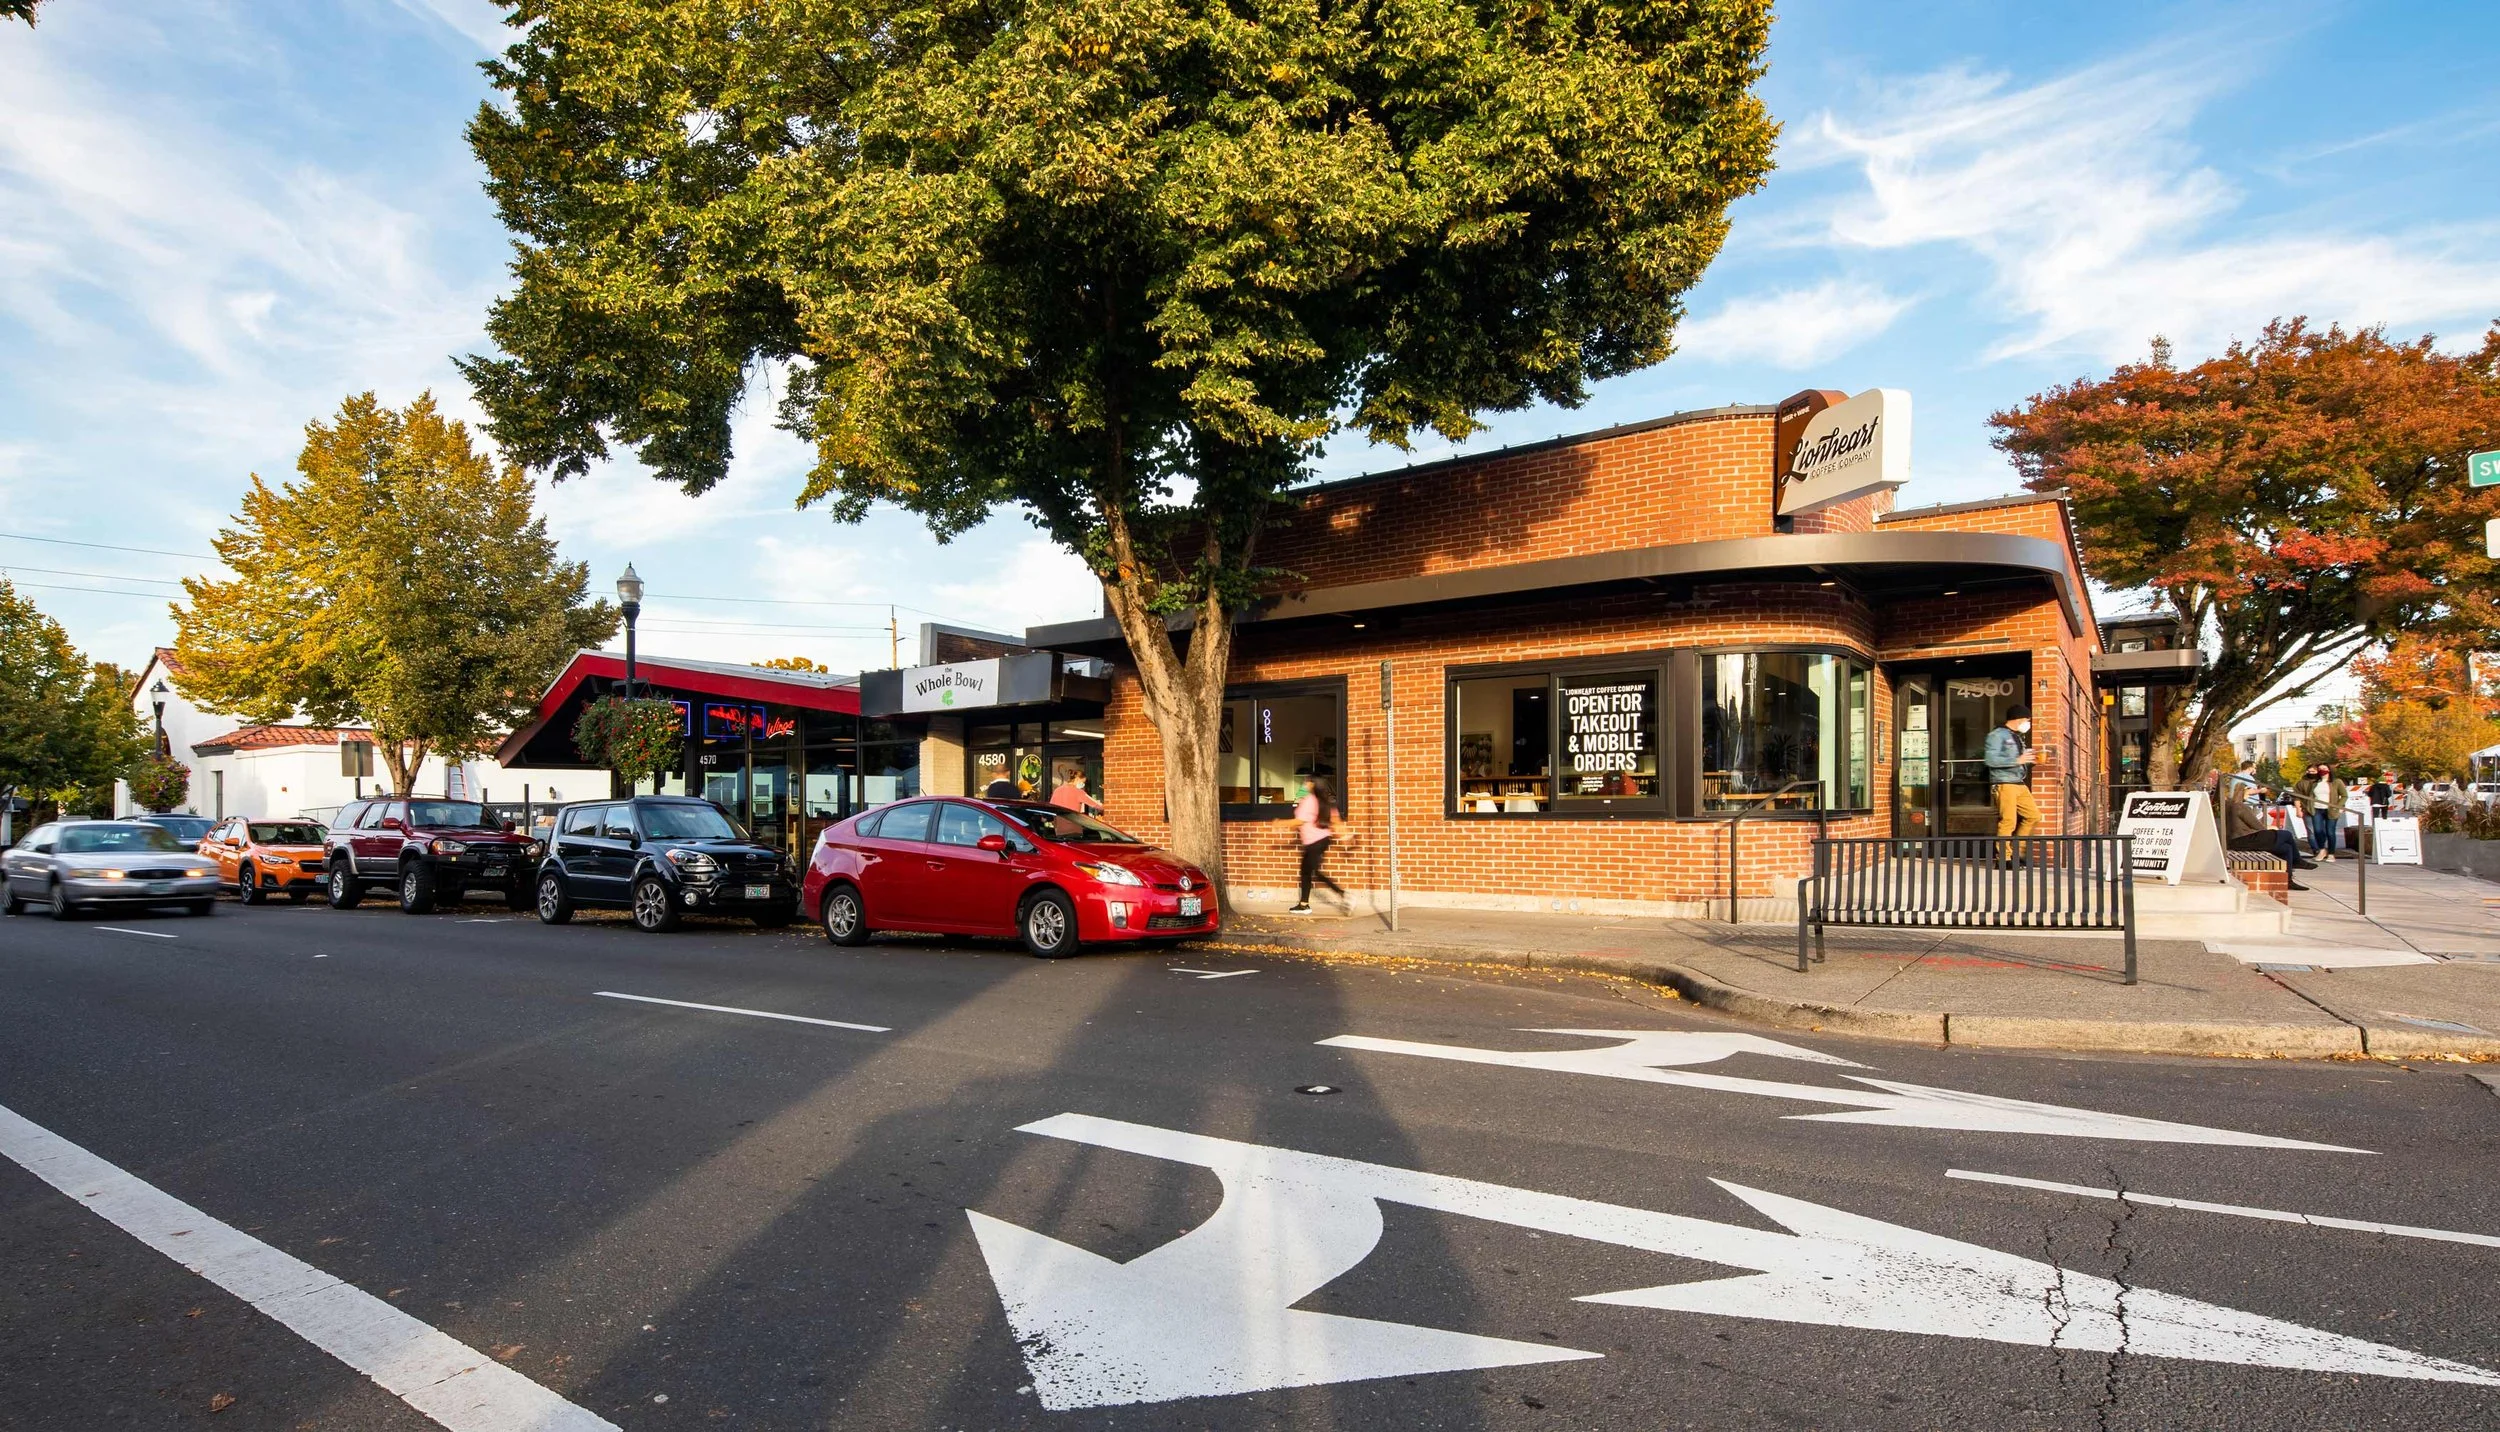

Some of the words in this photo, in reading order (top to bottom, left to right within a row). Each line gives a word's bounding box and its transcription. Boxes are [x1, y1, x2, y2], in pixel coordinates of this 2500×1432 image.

[1781, 415, 1879, 487] Lionheart
[1811, 462, 1837, 479] COFFEE
[1839, 449, 1872, 470] COMPANY
[915, 674, 952, 696] Whole
[955, 672, 984, 692] Bowl
[1565, 687, 1596, 696] LIONHEART
[1596, 686, 1617, 694] COFFEE
[1617, 684, 1646, 692] COMPANY
[1568, 695, 1609, 715] OPEN
[1612, 693, 1642, 712] FOR
[766, 717, 795, 736] Wings
[1570, 713, 1641, 733] TAKEOUT
[1568, 735, 1579, 752] &
[1583, 732, 1643, 752] MOBILE
[700, 755, 717, 764] 4570
[978, 753, 1005, 766] 4580
[1574, 752, 1637, 771] ORDERS
[2132, 800, 2184, 815] Lionheart
[2132, 827, 2155, 835] COFFEE
[2162, 828, 2173, 836] TEA
[2132, 837, 2144, 845] OTS
[2155, 838, 2172, 846] FOOD
[2131, 847, 2144, 855] EER
[2152, 848, 2168, 856] WINE
[2132, 859, 2167, 868] MMUNITY
